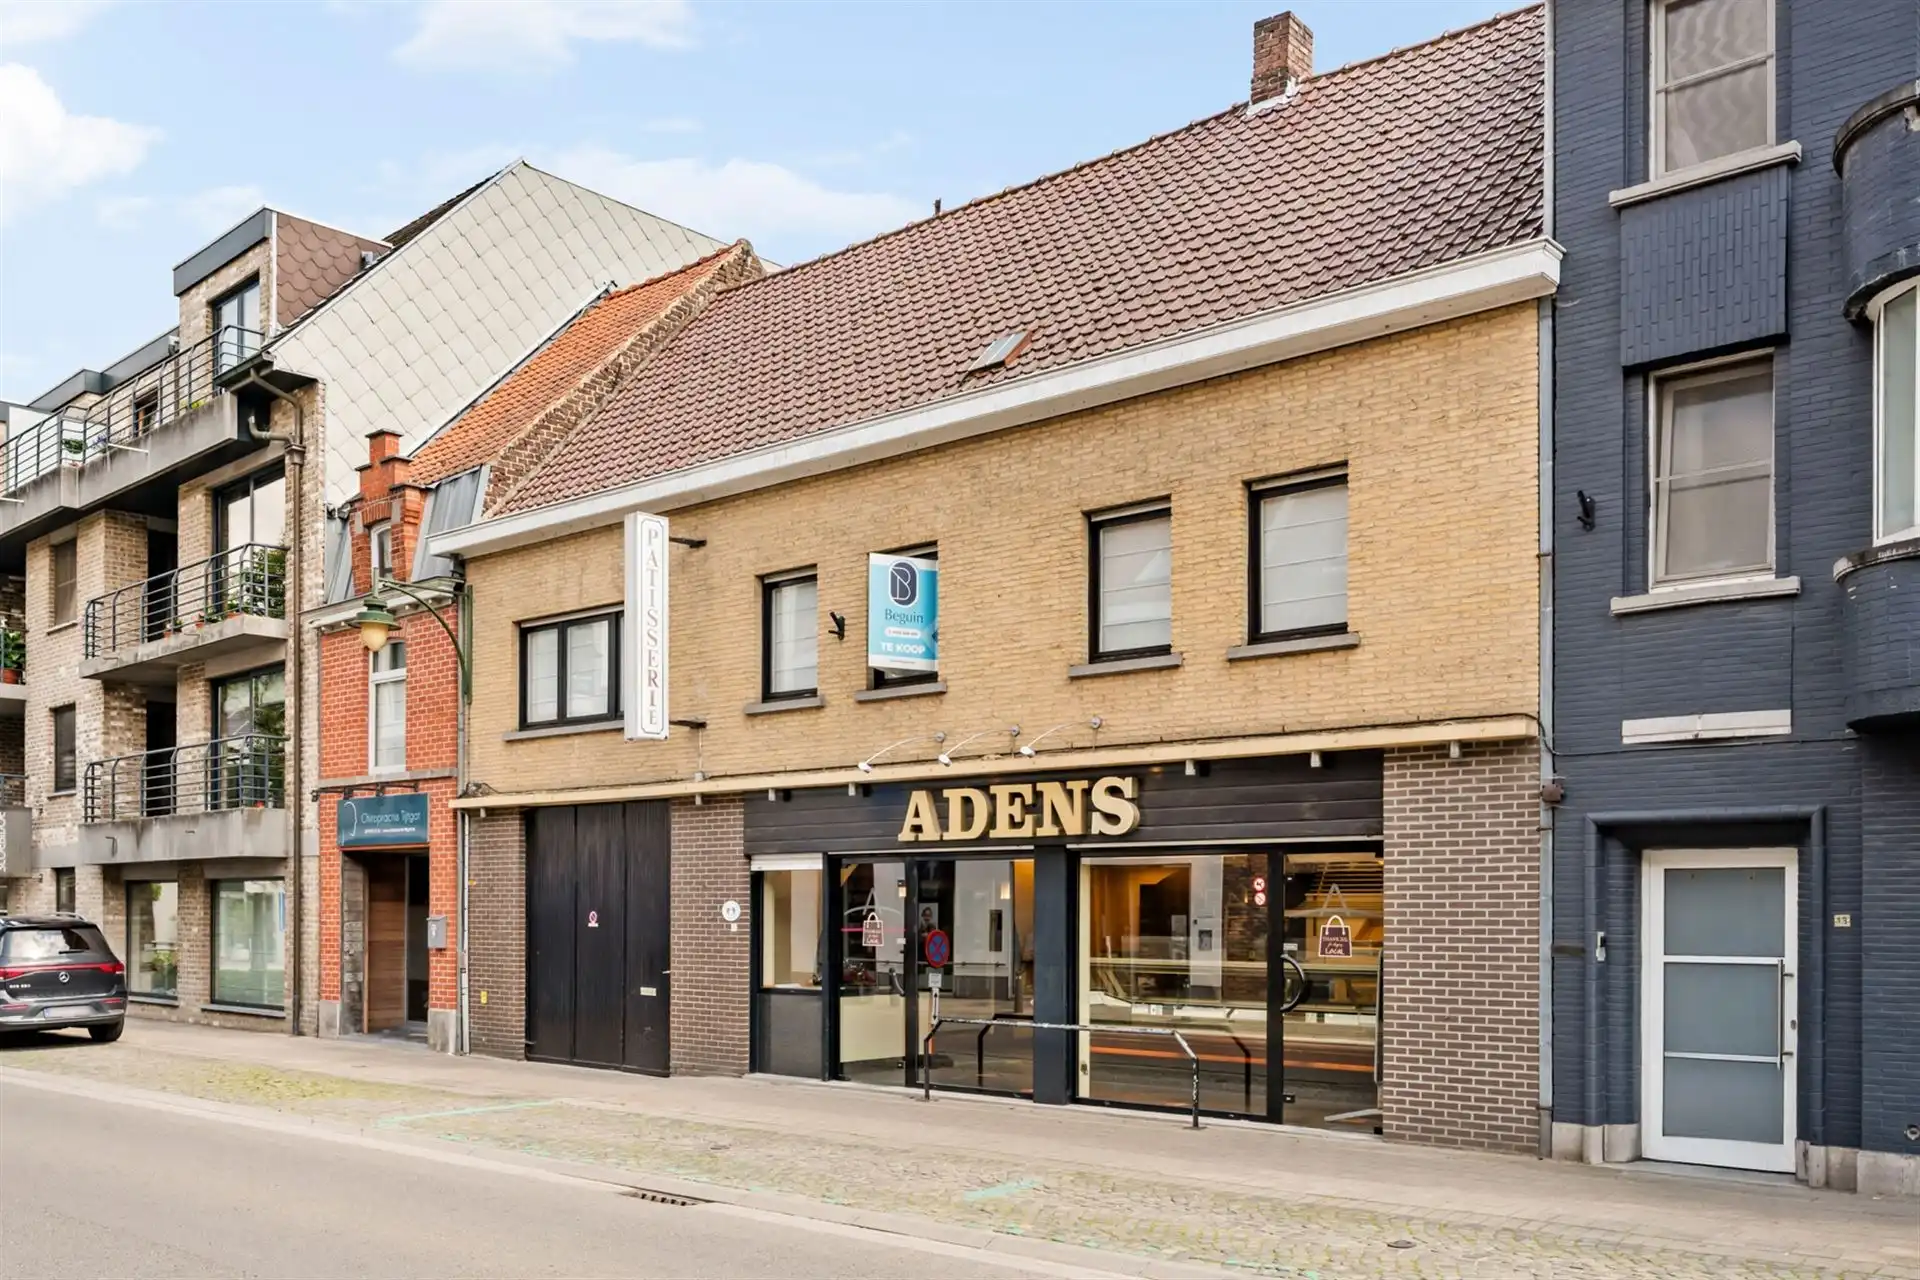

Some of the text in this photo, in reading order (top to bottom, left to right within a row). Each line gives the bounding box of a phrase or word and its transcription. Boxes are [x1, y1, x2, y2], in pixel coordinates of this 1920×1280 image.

[645, 527, 660, 726] PATISSERIE
[884, 608, 925, 625] Beguin
[880, 641, 926, 655] TE KOOP
[897, 776, 1141, 842] ADENS
